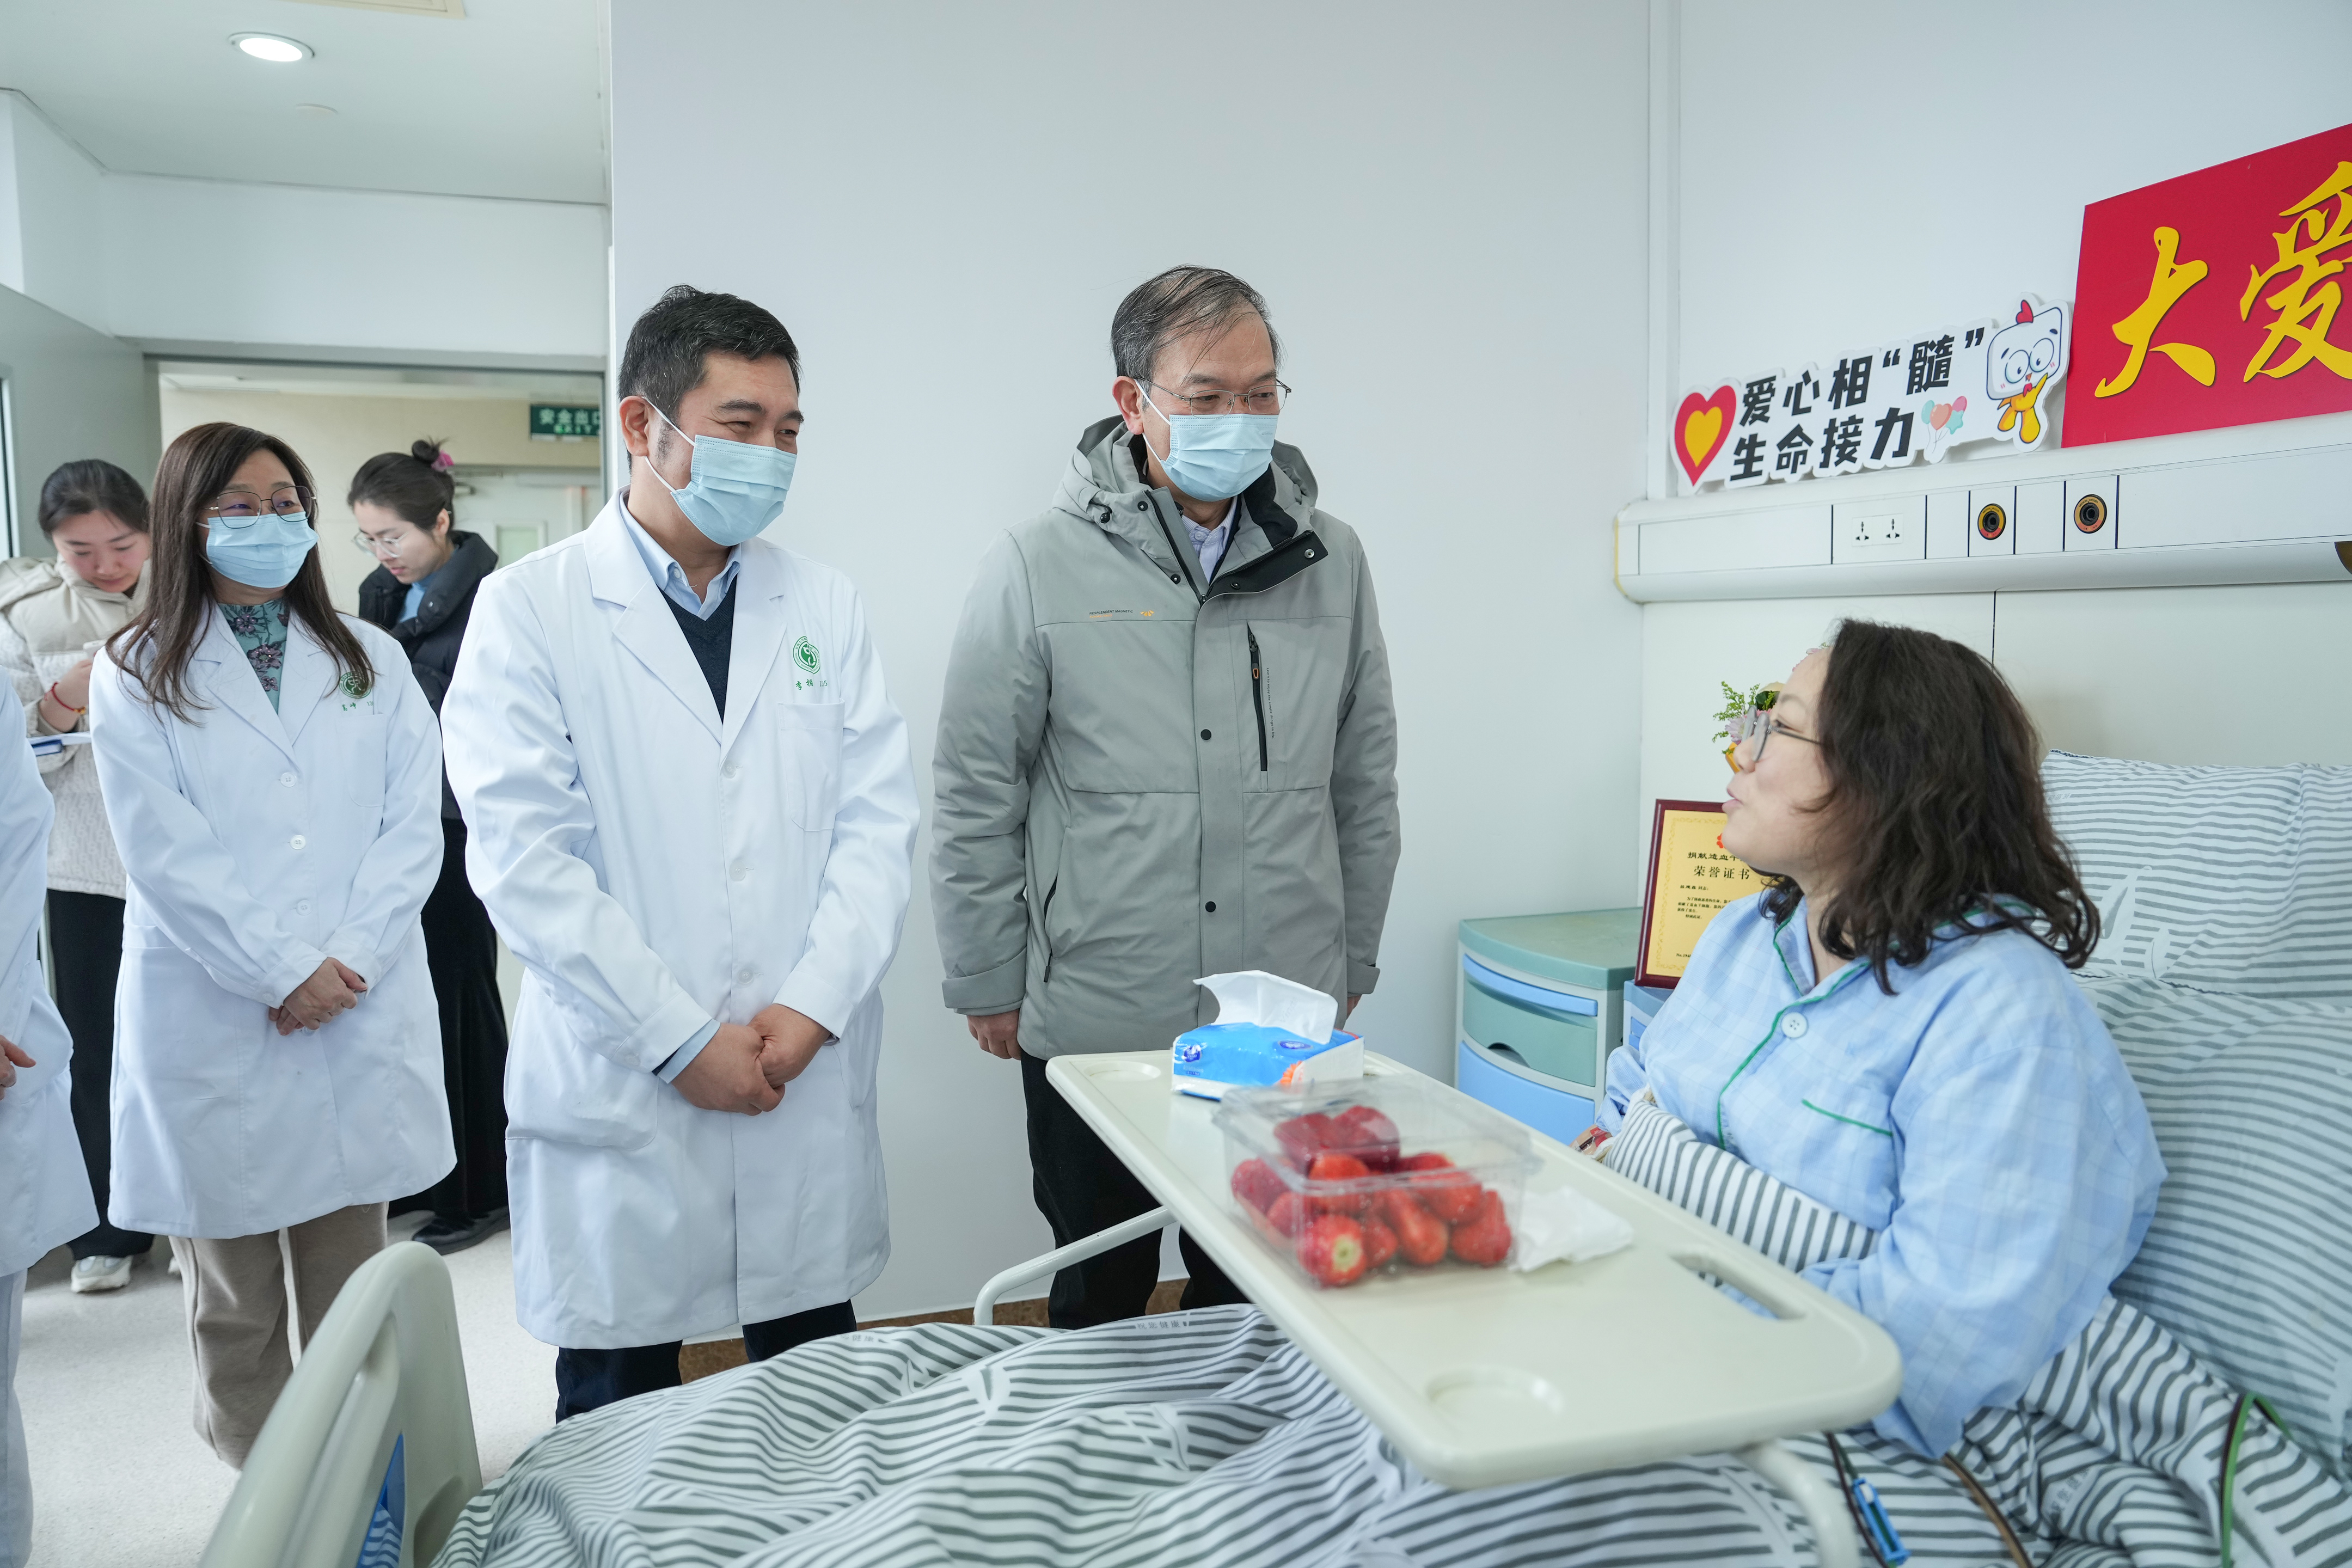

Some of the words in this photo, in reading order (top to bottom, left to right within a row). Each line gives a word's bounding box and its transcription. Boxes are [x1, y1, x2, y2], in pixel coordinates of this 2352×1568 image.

[2094, 161, 2352, 399] 大爱
[1739, 327, 1985, 427] 爱心相“髓”
[1729, 406, 1915, 483] 生命接力
[2079, 499, 2088, 507] MEDICAL
[1687, 852, 1743, 861] 捐献造血干
[1694, 865, 1749, 880] 荣誉证书
[1136, 1320, 1180, 1329] 祝您健康
